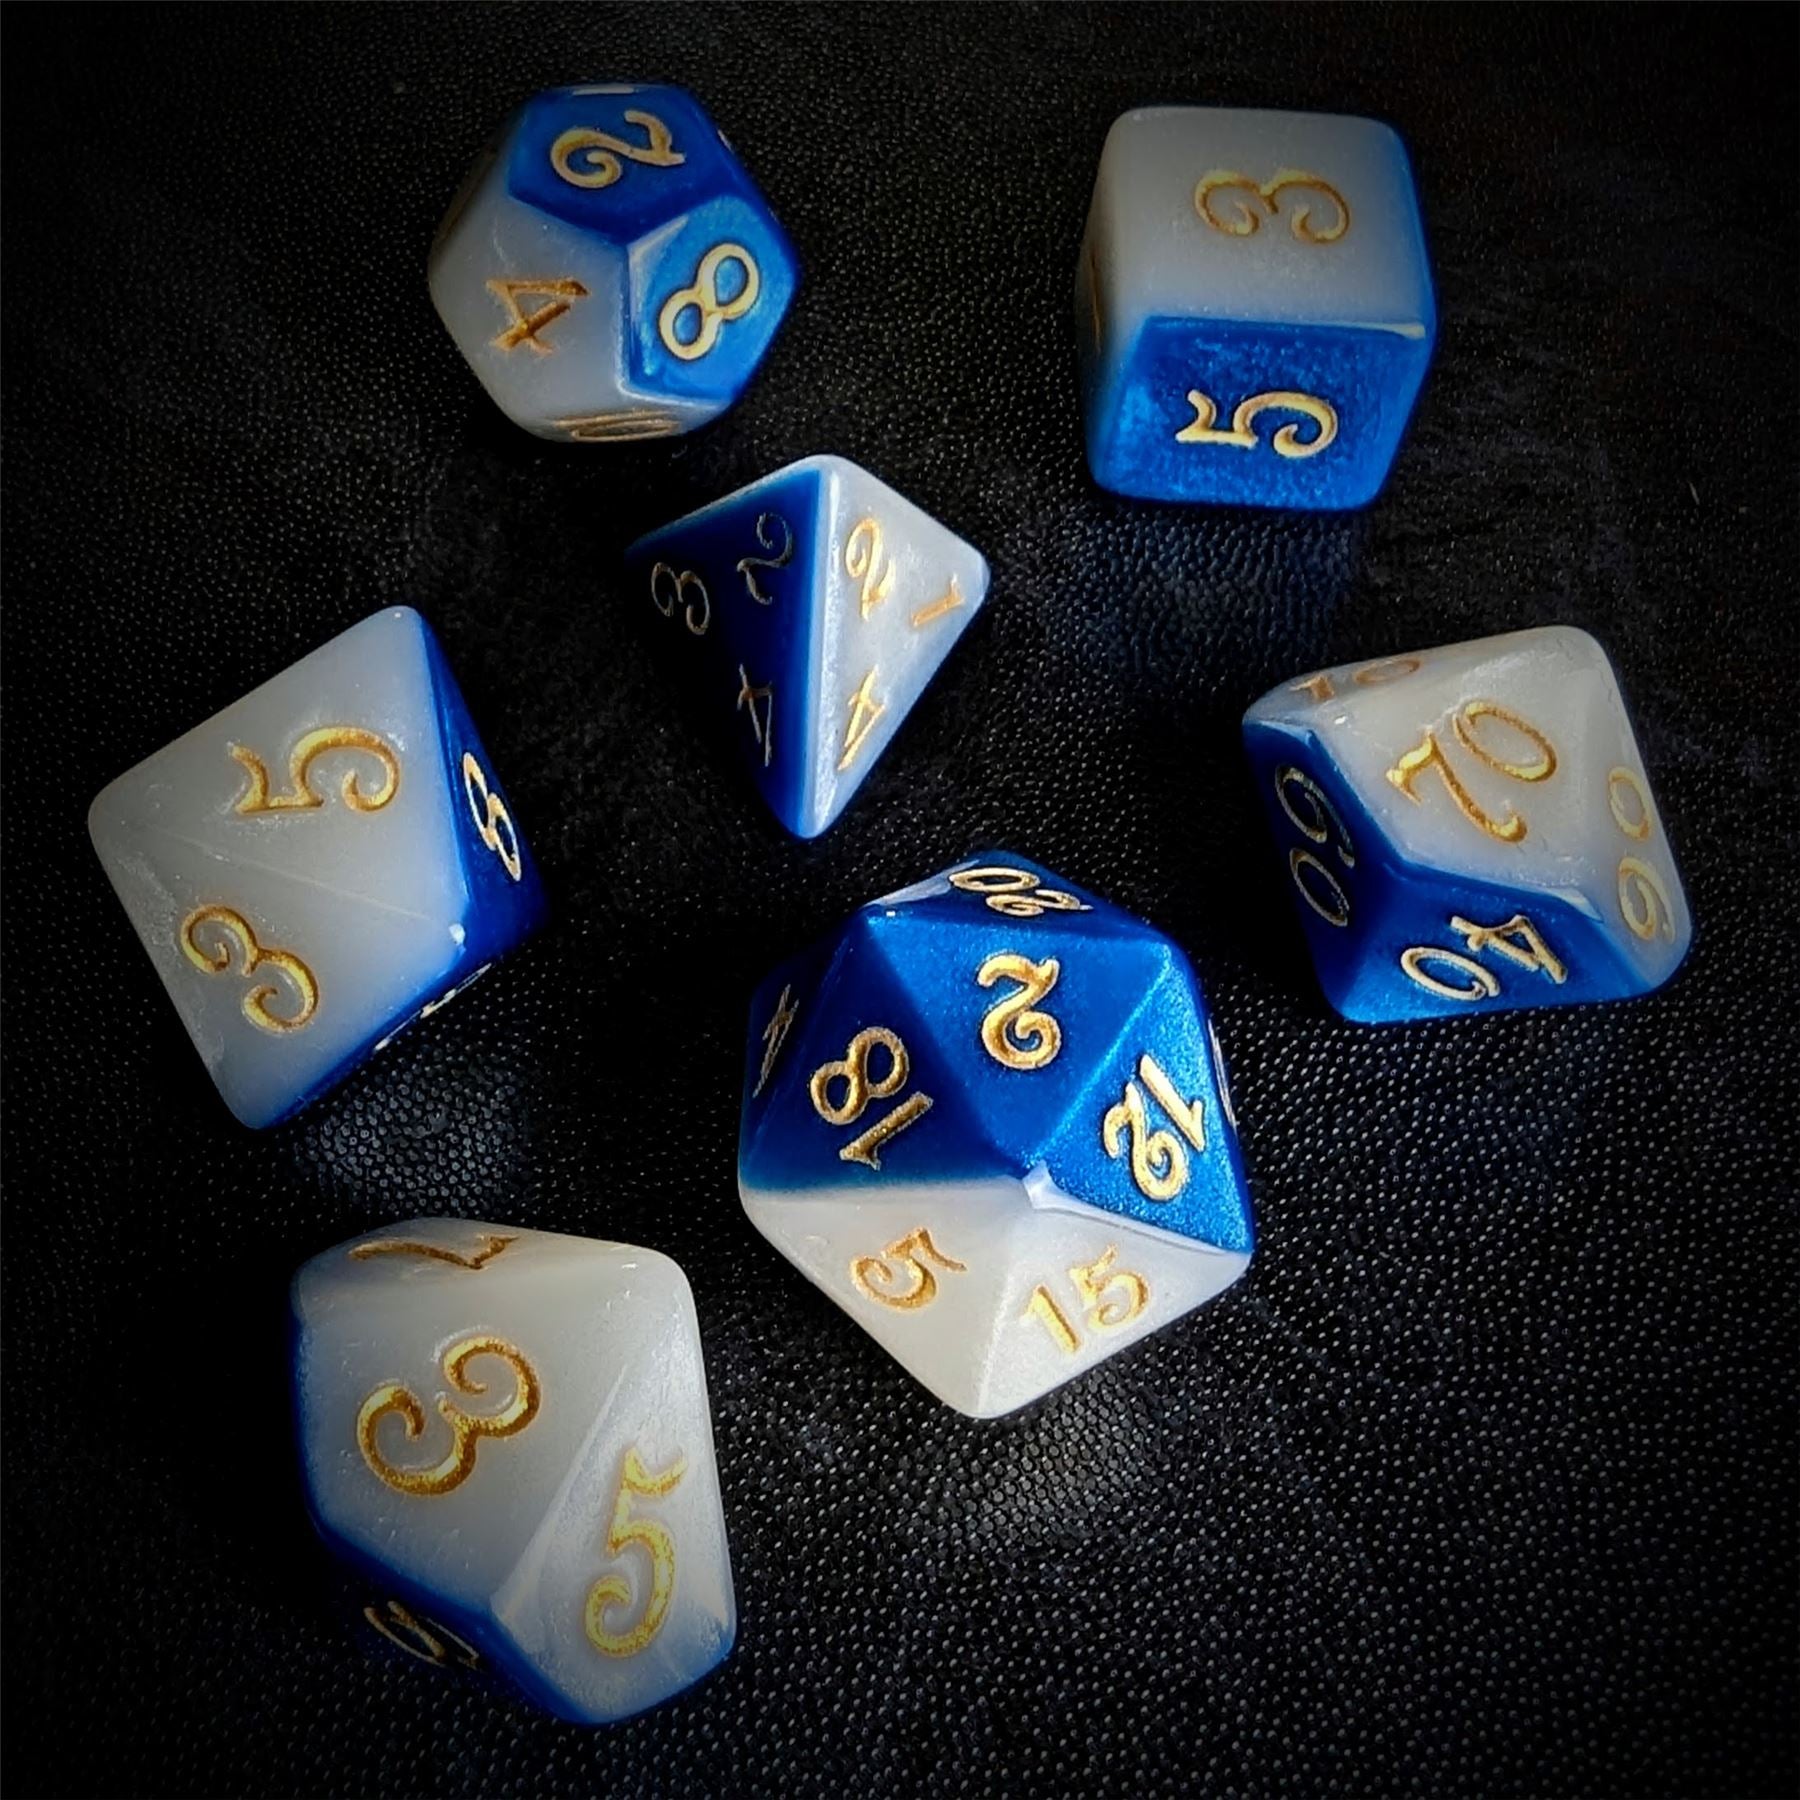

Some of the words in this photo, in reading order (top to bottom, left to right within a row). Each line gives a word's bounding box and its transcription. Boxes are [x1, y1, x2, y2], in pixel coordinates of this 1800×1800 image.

[550, 109, 687, 189] 2
[1194, 168, 1351, 245] 3
[485, 276, 590, 356] 4
[658, 241, 760, 361] 8
[1175, 389, 1338, 459] 5
[651, 561, 711, 635] 3
[737, 512, 793, 605] 2
[846, 516, 896, 621] 2
[911, 572, 966, 627] 1
[737, 664, 773, 768] 4
[837, 664, 886, 771] 4
[1290, 658, 1423, 701] 10
[227, 725, 401, 814] 5
[463, 752, 522, 882] 8
[1386, 700, 1558, 844] 70
[948, 867, 1094, 917] 20
[178, 903, 321, 1034] 3
[1400, 914, 1568, 1001] 40
[976, 951, 1062, 1071] 2
[810, 1026, 934, 1171] 18
[1103, 1053, 1207, 1202] 12
[849, 1226, 969, 1313] 5
[1022, 1243, 1151, 1355] 15
[356, 1334, 542, 1497] 3
[584, 1443, 690, 1659] 5
